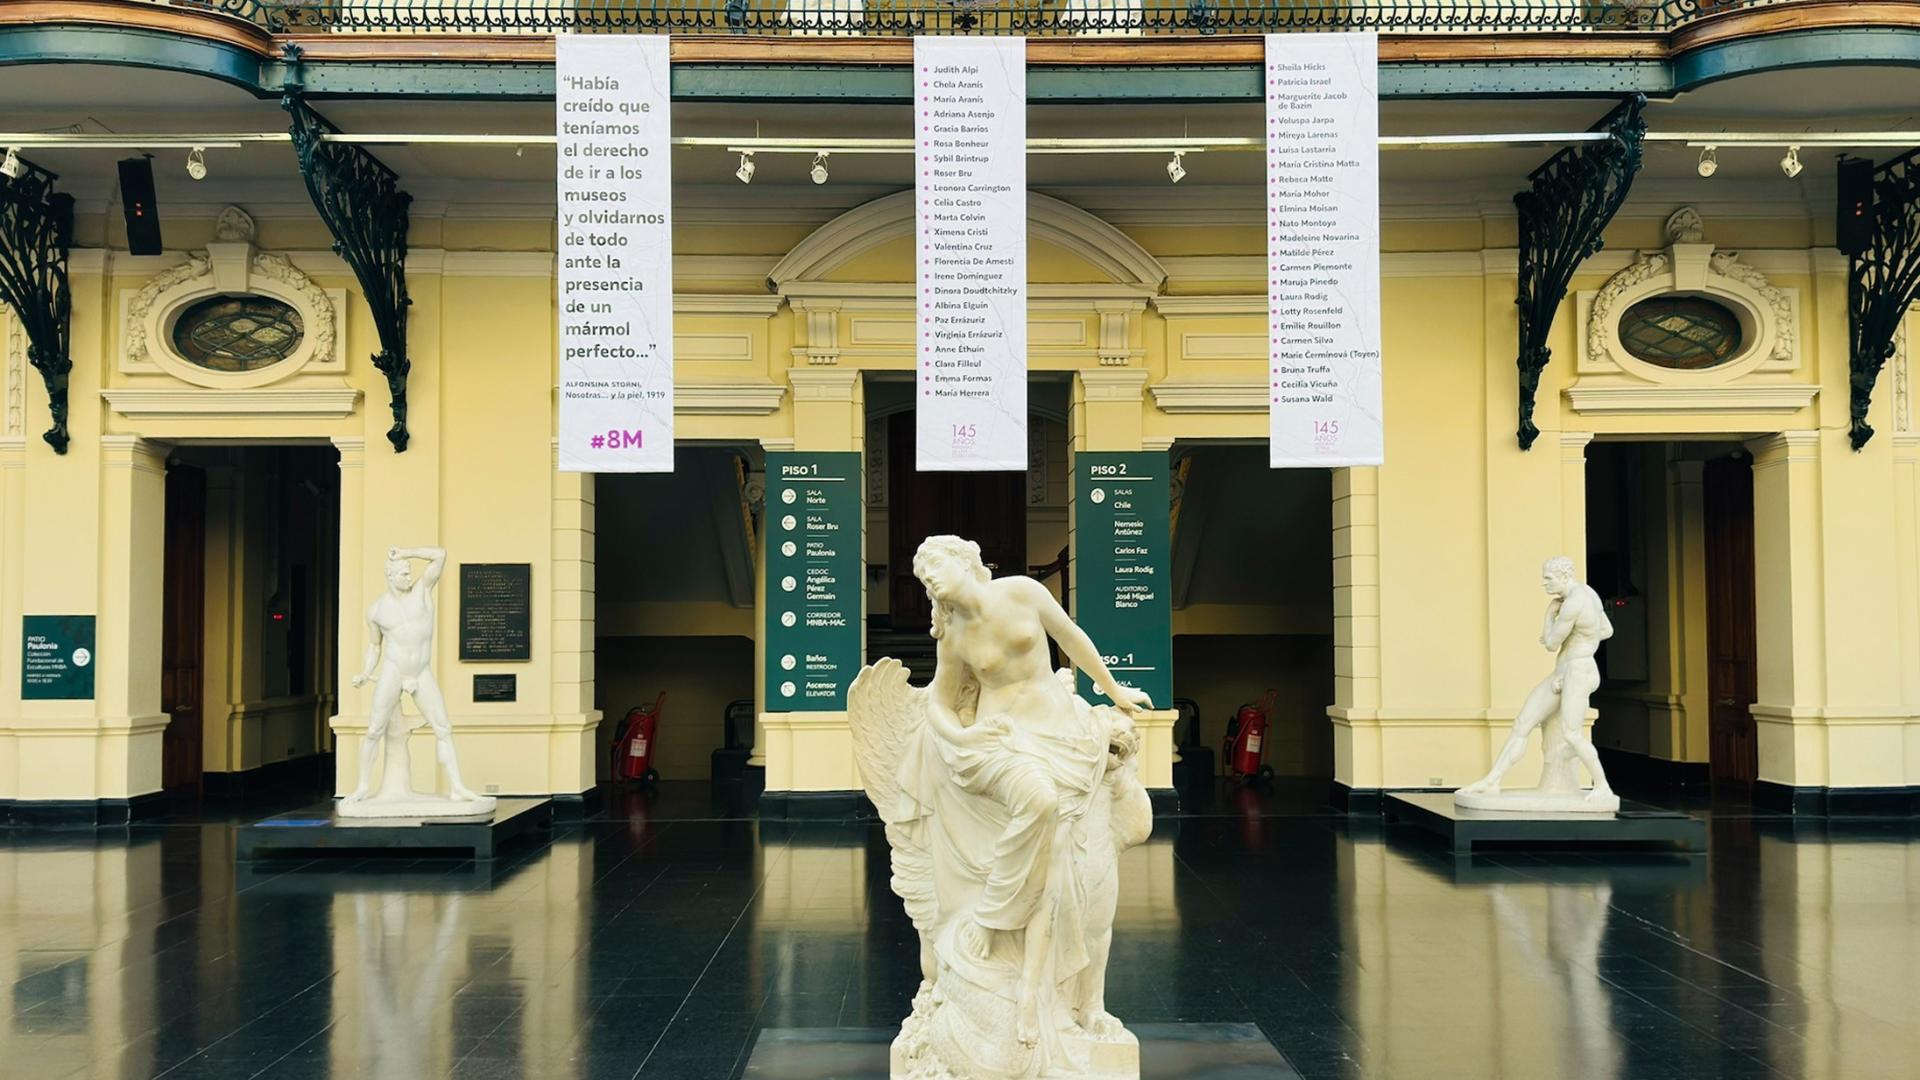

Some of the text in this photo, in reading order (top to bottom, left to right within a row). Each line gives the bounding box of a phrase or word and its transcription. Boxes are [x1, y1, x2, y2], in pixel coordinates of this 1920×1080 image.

[961, 66, 978, 75] Alpi
[1303, 63, 1326, 71] Hicks
[563, 75, 619, 90] “Había
[1277, 78, 1308, 86] Patricia
[1278, 92, 1347, 102] Marguerite Jacob
[563, 98, 650, 115] creído que
[968, 111, 995, 120] Asenjo
[1278, 117, 1335, 126] Voluspa Jarpa
[563, 121, 639, 135] teníamos
[933, 125, 988, 133] Gracia Barrios
[1278, 131, 1338, 140] Mireya Larenas
[564, 143, 648, 157] el derecho
[1278, 146, 1299, 154] Luisa
[934, 155, 989, 163] Sybil Brintrup
[564, 165, 642, 180] de ir a los
[968, 184, 1011, 193] Carrington
[565, 190, 626, 202] museos
[934, 199, 982, 207] Celia Castro
[564, 210, 664, 226] y olvidarnos
[1301, 219, 1337, 228] Montoya
[934, 228, 988, 236] Ximena Cristi
[565, 233, 628, 246] de todo
[1279, 234, 1321, 242] Madeleine
[565, 255, 620, 269] ante la
[565, 277, 643, 294] presencia
[1280, 279, 1308, 287] Maruja
[935, 287, 961, 295] Dinora
[1304, 293, 1328, 301] Rodig
[565, 299, 612, 313] de un
[1280, 308, 1301, 316] Lotty
[565, 322, 630, 336] mármol
[1281, 322, 1306, 330] Emilie
[935, 331, 966, 340] Virginia
[1349, 350, 1379, 359] (Toyen)
[935, 360, 982, 368] Clara Filleul
[610, 392, 616, 400] y
[617, 391, 625, 399] la
[627, 391, 645, 400] piel,
[646, 391, 665, 399] 1919
[952, 424, 976, 437] 145
[1314, 420, 1339, 434] 145
[590, 430, 643, 448] #8M
[782, 464, 817, 475] PISO 1
[1090, 464, 1127, 475] PISO 2
[1114, 501, 1131, 509] Chile
[1134, 566, 1154, 574] Rodig
[1122, 654, 1134, 664] -1
